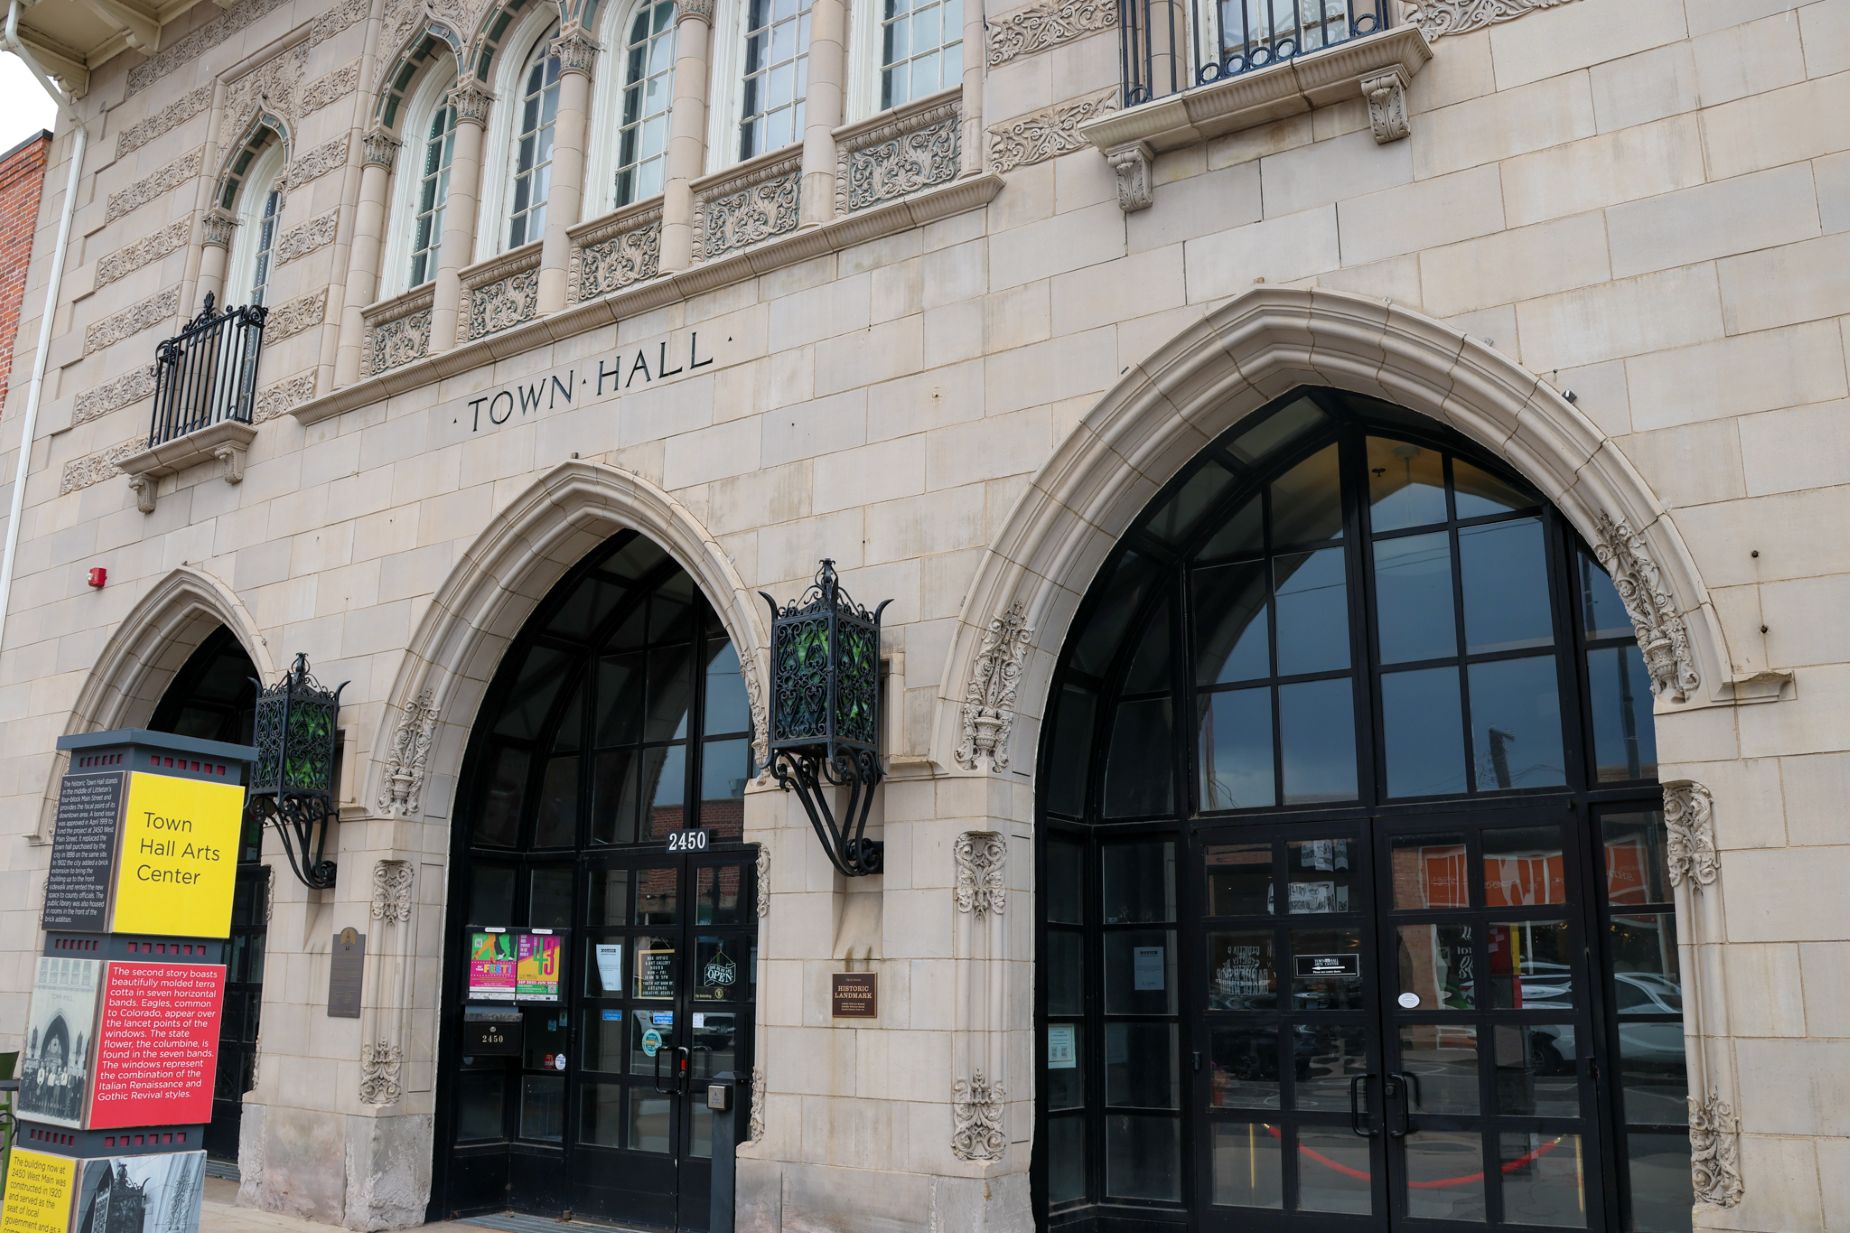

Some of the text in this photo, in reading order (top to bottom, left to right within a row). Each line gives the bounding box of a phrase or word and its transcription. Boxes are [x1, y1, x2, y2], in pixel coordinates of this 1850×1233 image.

[468, 332, 713, 432] TOWN HALL
[144, 812, 192, 832] Town
[669, 832, 706, 850] 2450
[140, 838, 220, 861] Hall Arts
[137, 864, 200, 884] Center
[113, 967, 218, 978] The second story boasts
[708, 970, 733, 982] OPEN
[112, 978, 158, 988] beautifully
[142, 999, 172, 1008] Eagles,
[120, 1009, 162, 1018] Colorado,
[165, 1010, 194, 1019] appear
[154, 1020, 180, 1029] points
[106, 1030, 147, 1038] windows.
[482, 1034, 504, 1042] 2450
[104, 1040, 134, 1048] flower,
[103, 1050, 129, 1058] found
[187, 1049, 214, 1057] bands.
[103, 1061, 118, 1069] The
[163, 1060, 203, 1068] represent
[118, 1071, 173, 1079] combination
[99, 1082, 127, 1090] Italian
[130, 1080, 183, 1089] Renaissance
[98, 1091, 191, 1101] Gothic Revival styles.
[14, 1156, 23, 1166] The
[25, 1160, 46, 1172] building
[47, 1164, 58, 1173] now
[12, 1168, 66, 1187] 2450 West Main was
[10, 1181, 42, 1194] constructed
[50, 1187, 61, 1198] 1920
[9, 1192, 19, 1201] and
[20, 1195, 38, 1205] served
[46, 1200, 55, 1209] the
[7, 1205, 39, 1217] seat of local
